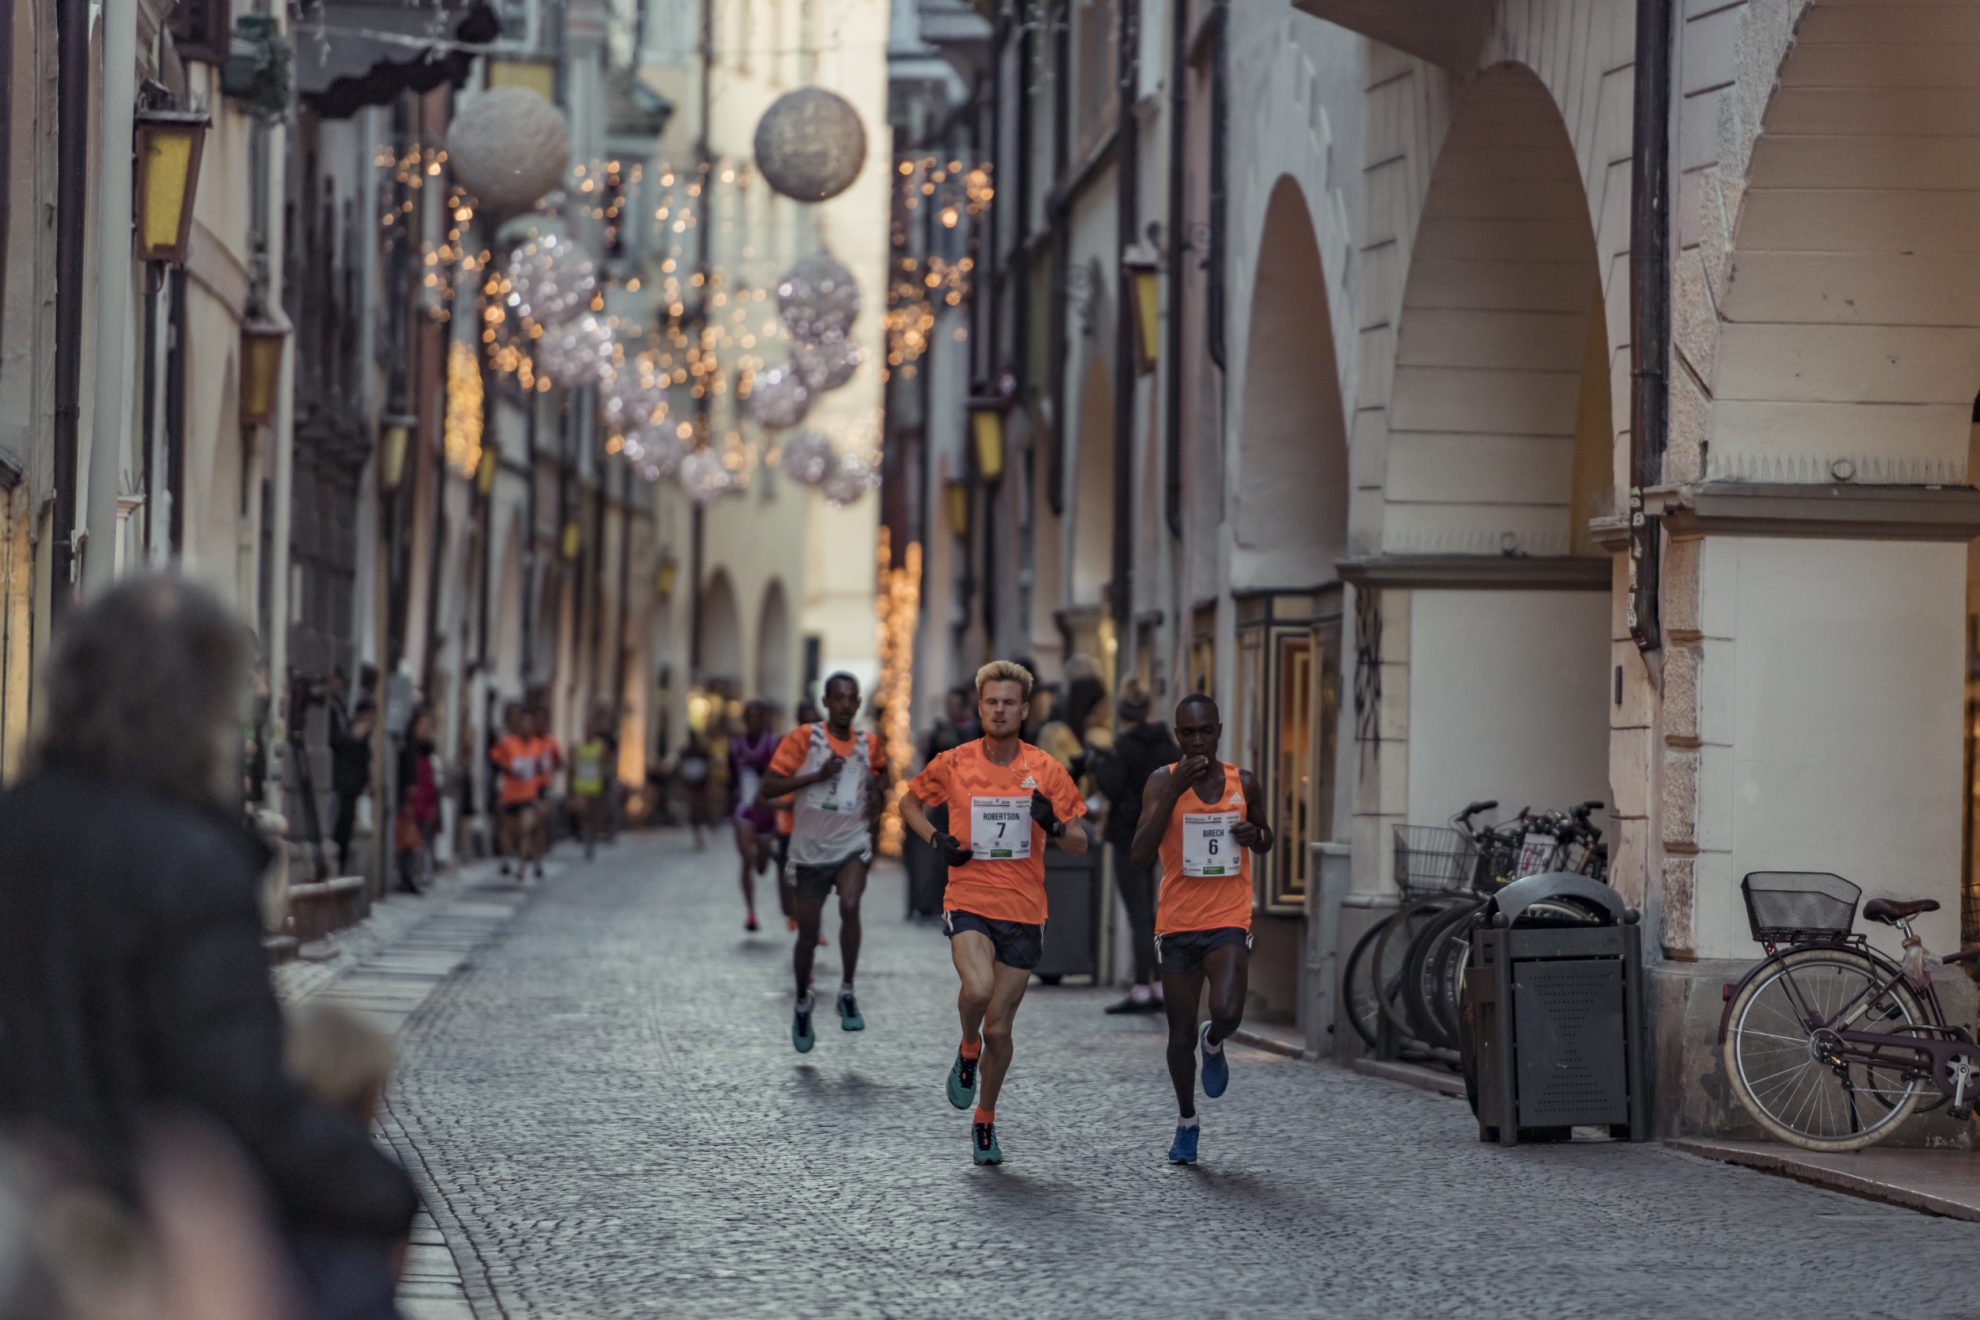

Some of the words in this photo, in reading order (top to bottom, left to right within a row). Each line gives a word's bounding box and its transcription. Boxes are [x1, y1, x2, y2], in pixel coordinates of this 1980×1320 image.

[829, 782, 838, 796] 3
[983, 812, 1020, 821] ROBERTSON
[996, 822, 1006, 838] 7
[1203, 829, 1224, 837] BIRECH
[1209, 839, 1218, 855] 6
